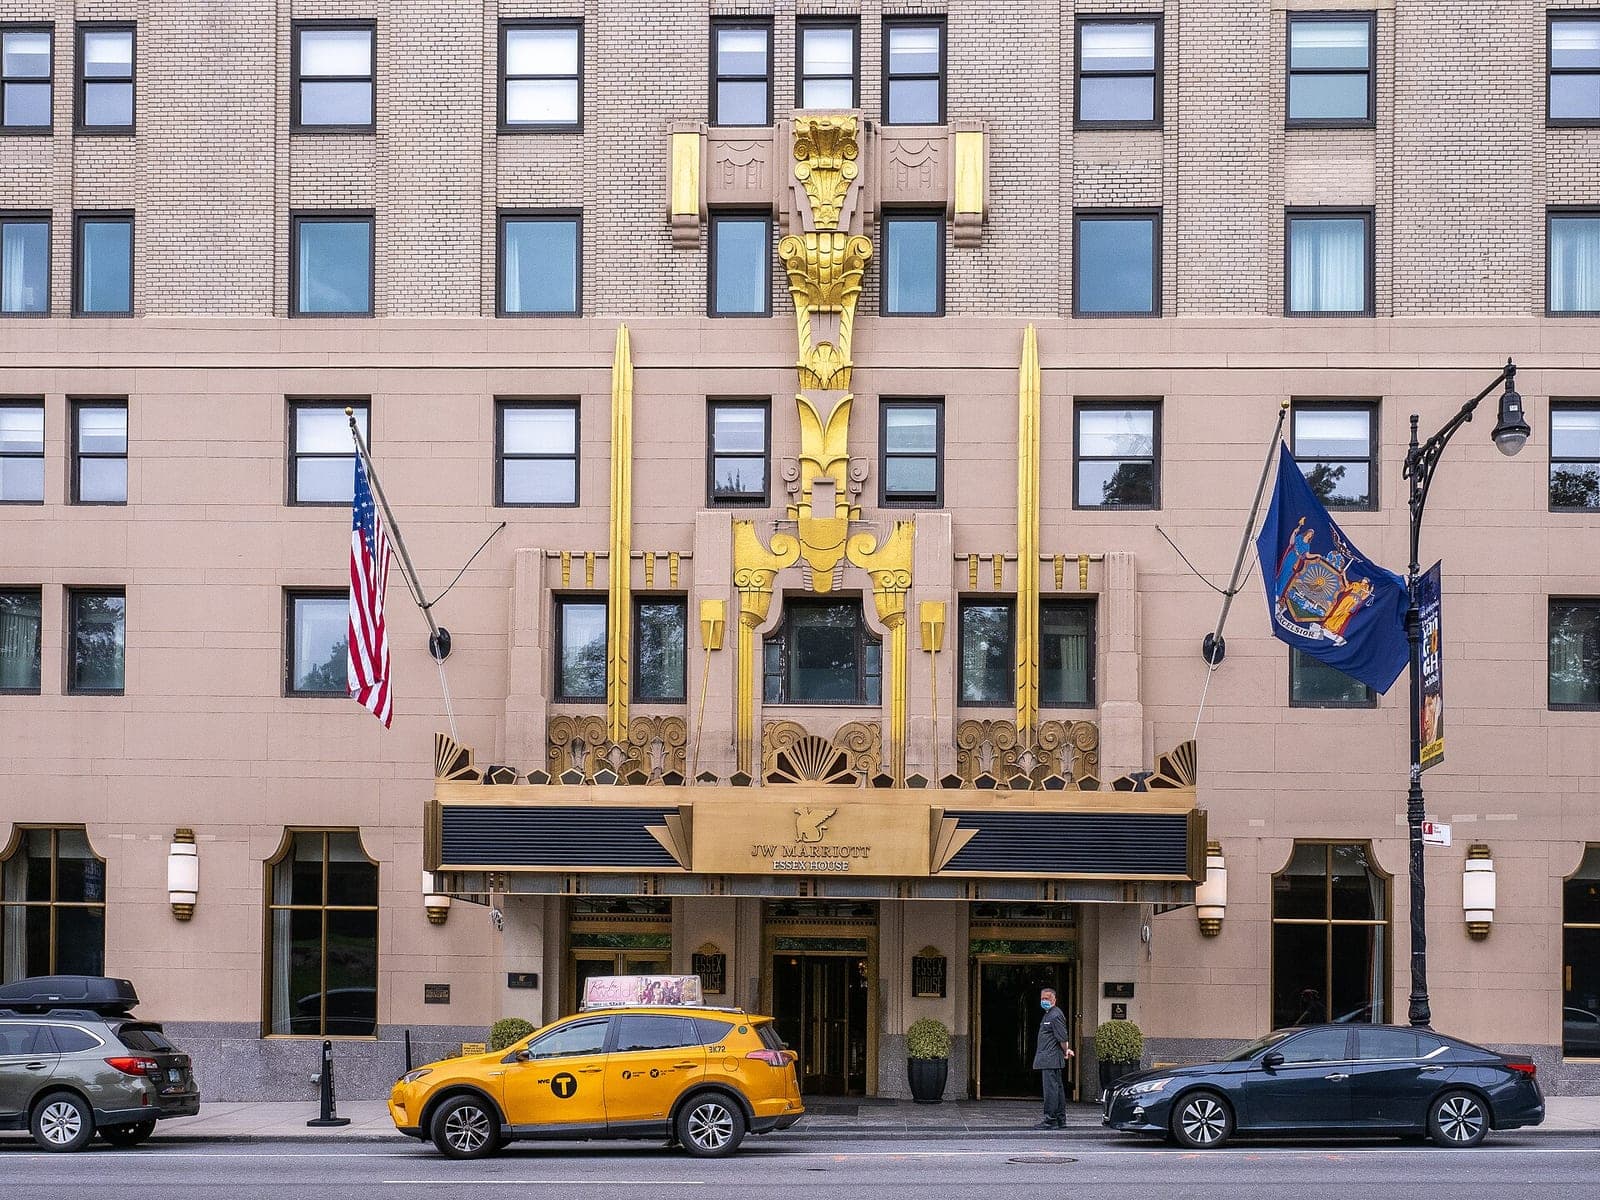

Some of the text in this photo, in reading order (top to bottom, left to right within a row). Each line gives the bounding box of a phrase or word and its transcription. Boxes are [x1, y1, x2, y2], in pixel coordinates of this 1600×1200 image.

[751, 844, 870, 859] JW MARRIOTT
[773, 860, 849, 872] ESSEX HOUSE
[695, 955, 722, 973] ESSEX
[916, 959, 943, 976] ESSEX
[700, 973, 721, 990] OUSE
[915, 976, 942, 993] HOUSE
[557, 1077, 571, 1096] T
